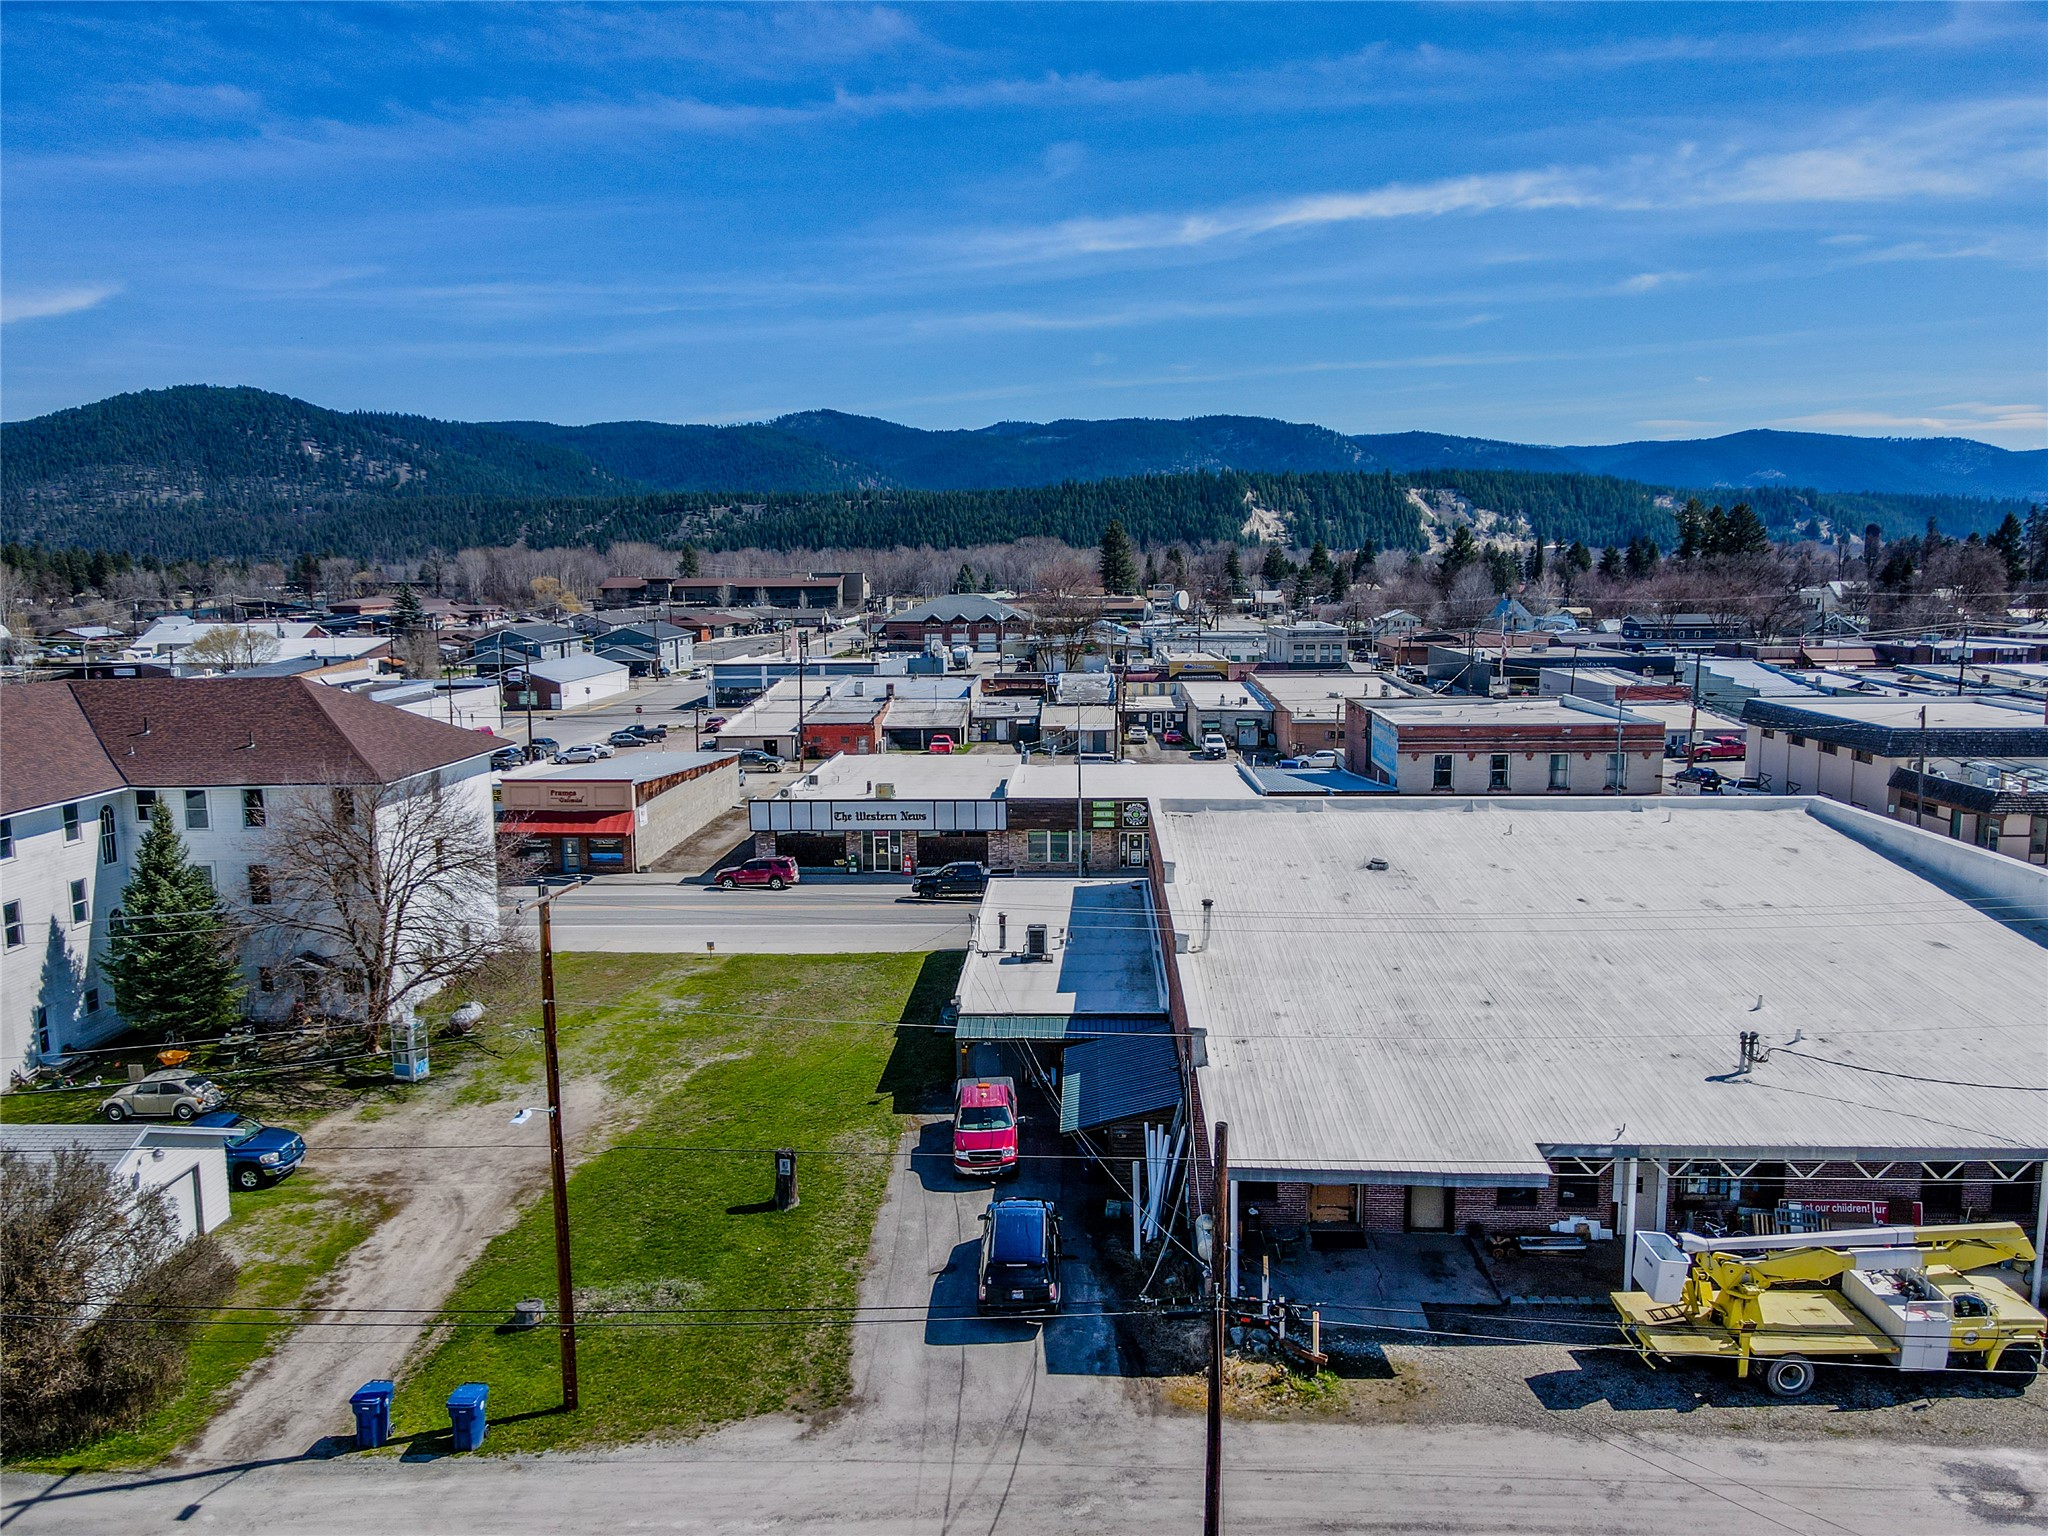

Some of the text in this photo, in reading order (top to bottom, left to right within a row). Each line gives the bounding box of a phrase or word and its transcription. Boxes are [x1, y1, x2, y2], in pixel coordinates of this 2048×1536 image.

[834, 811, 927, 822] The Western News
[1815, 1203, 1830, 1213] our
[1832, 1203, 1871, 1214] children!
